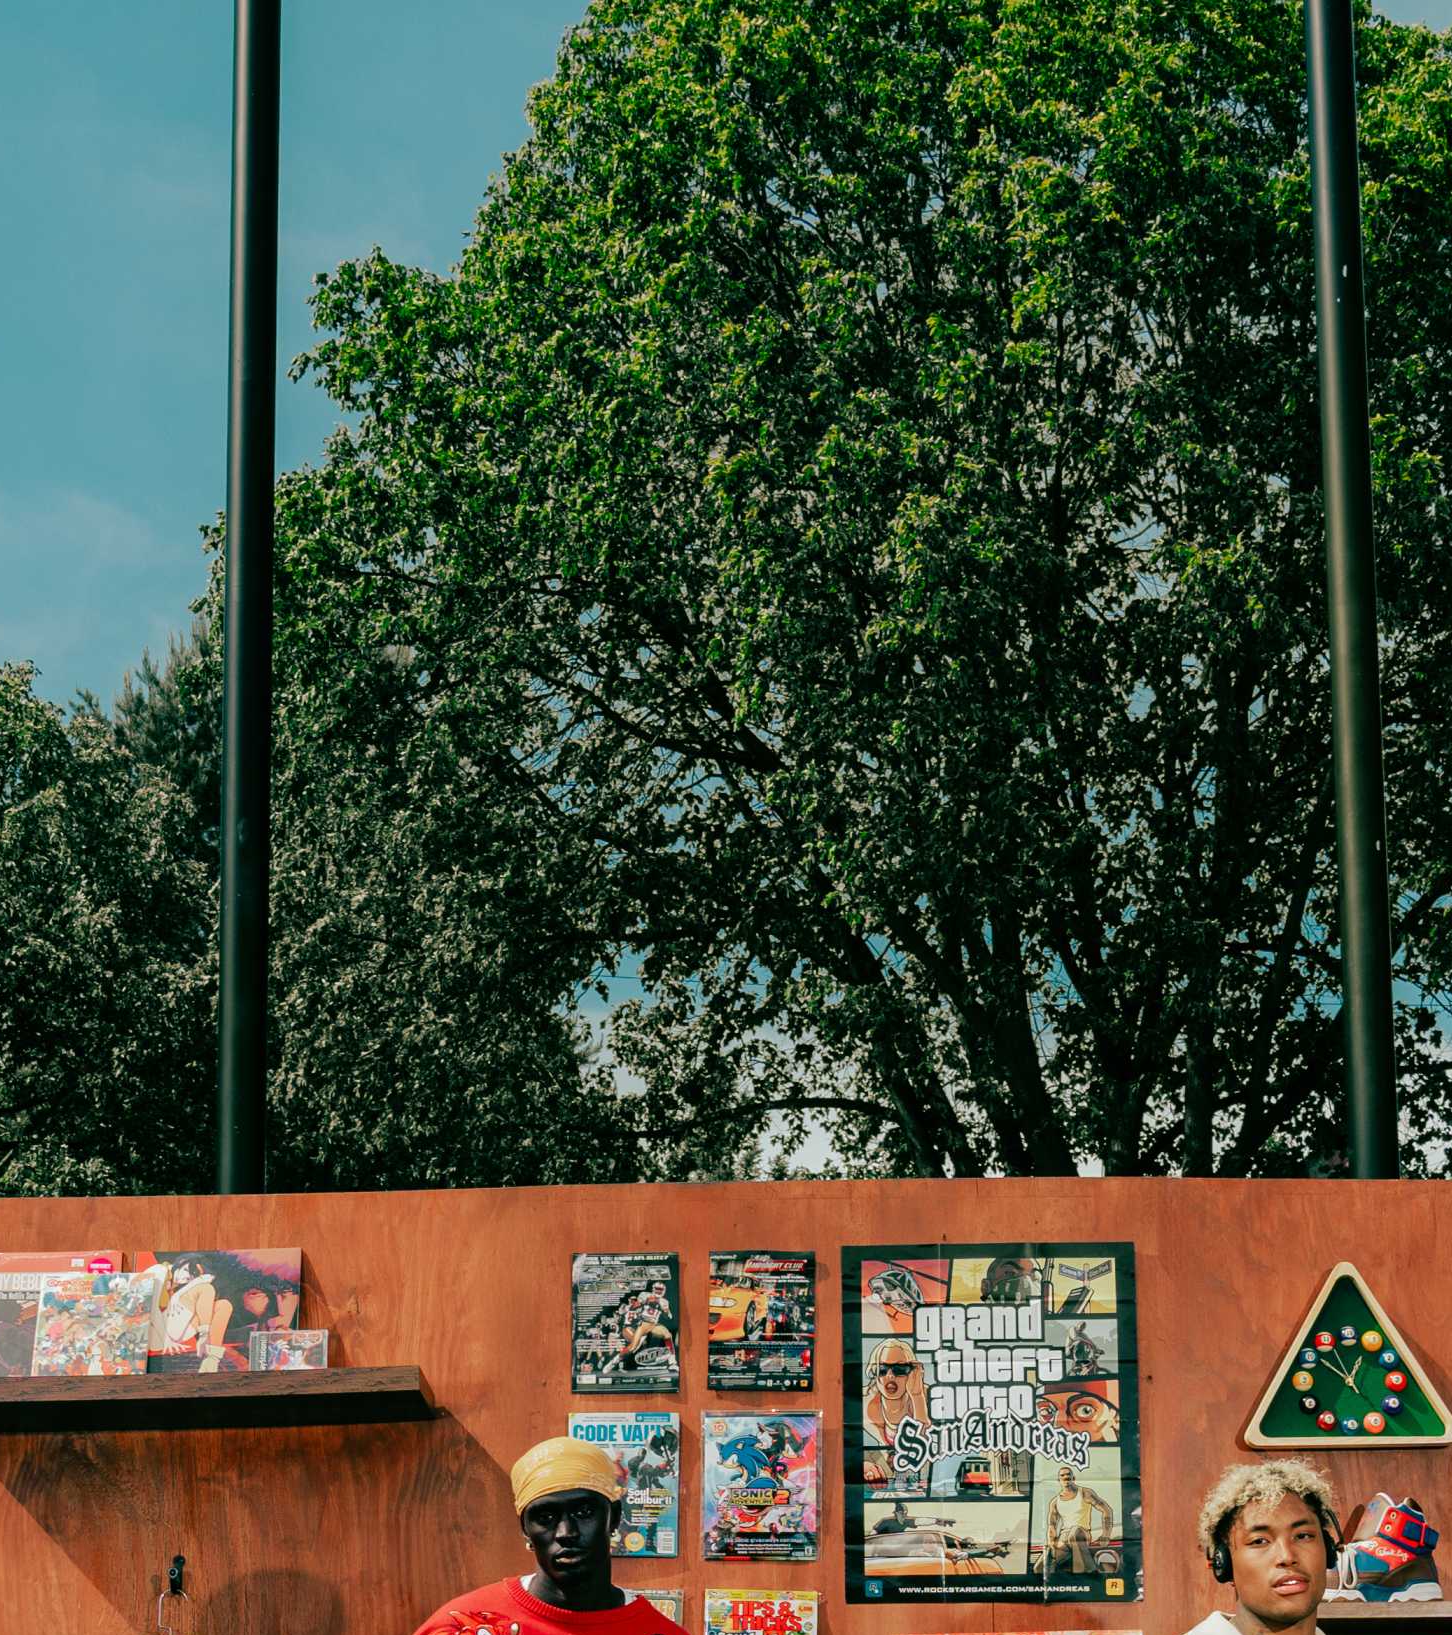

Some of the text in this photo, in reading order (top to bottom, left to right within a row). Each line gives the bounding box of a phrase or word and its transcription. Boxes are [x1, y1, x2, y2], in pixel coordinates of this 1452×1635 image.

[13, 1273, 42, 1291] BEBO
[937, 1344, 1064, 1382] theft
[931, 1385, 1033, 1420] auto
[573, 1424, 674, 1441] CODE VAUL
[895, 1406, 1089, 1472] San Andreas
[628, 1488, 649, 1497] Soul
[732, 1489, 772, 1498] SONIC
[730, 1600, 775, 1616] TIPS
[778, 1600, 796, 1616] &
[730, 1615, 803, 1631] TRICKS
